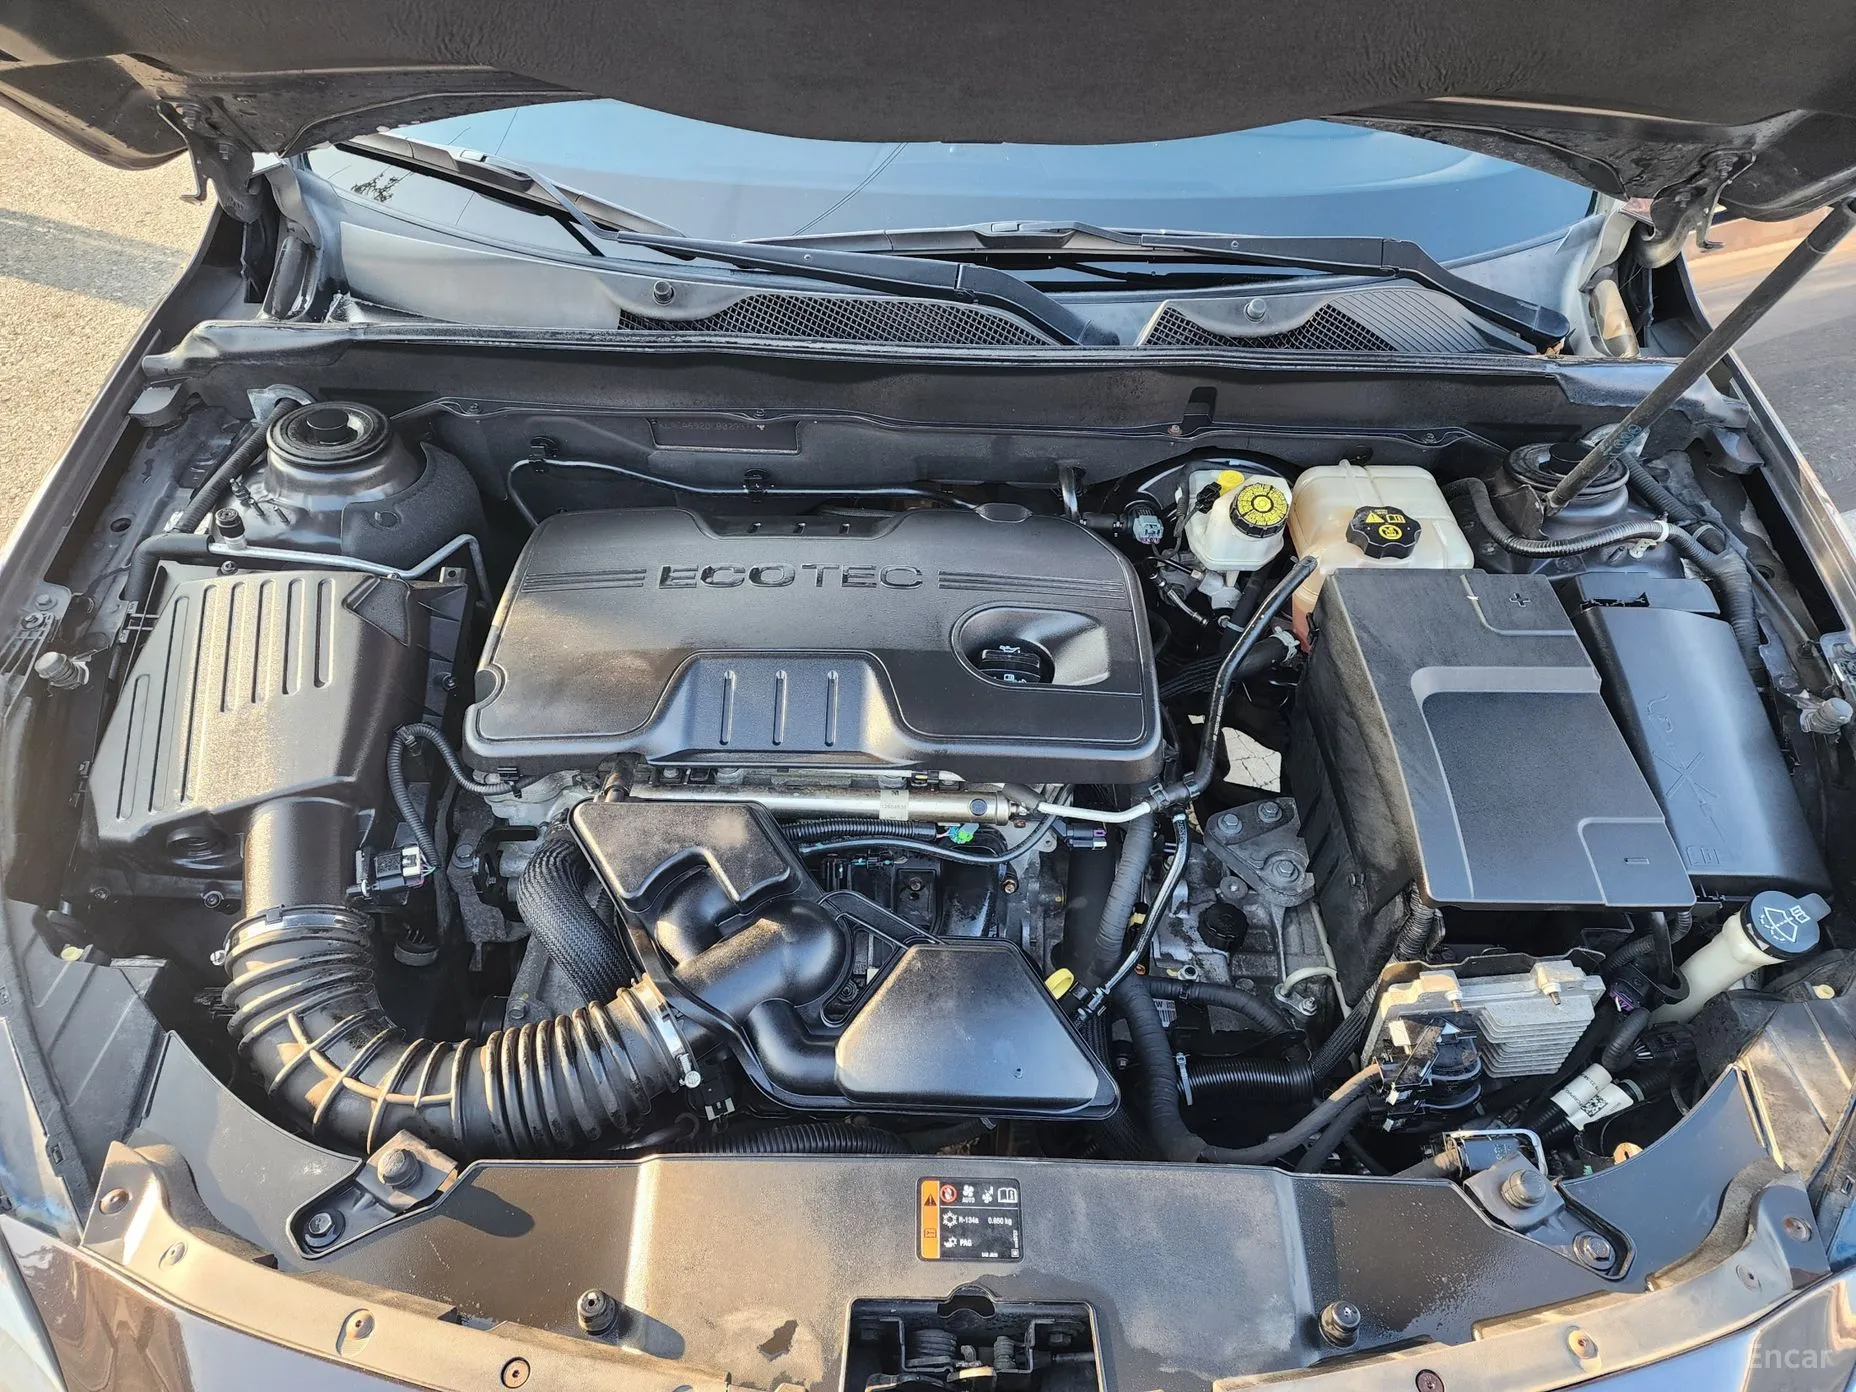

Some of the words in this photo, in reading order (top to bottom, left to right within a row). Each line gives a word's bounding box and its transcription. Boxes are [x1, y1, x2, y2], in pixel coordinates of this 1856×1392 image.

[658, 563, 923, 590] ECOTEC
[958, 1216, 979, 1225] R-134a
[1004, 1216, 1012, 1226] kg
[959, 1238, 972, 1247] PAG
